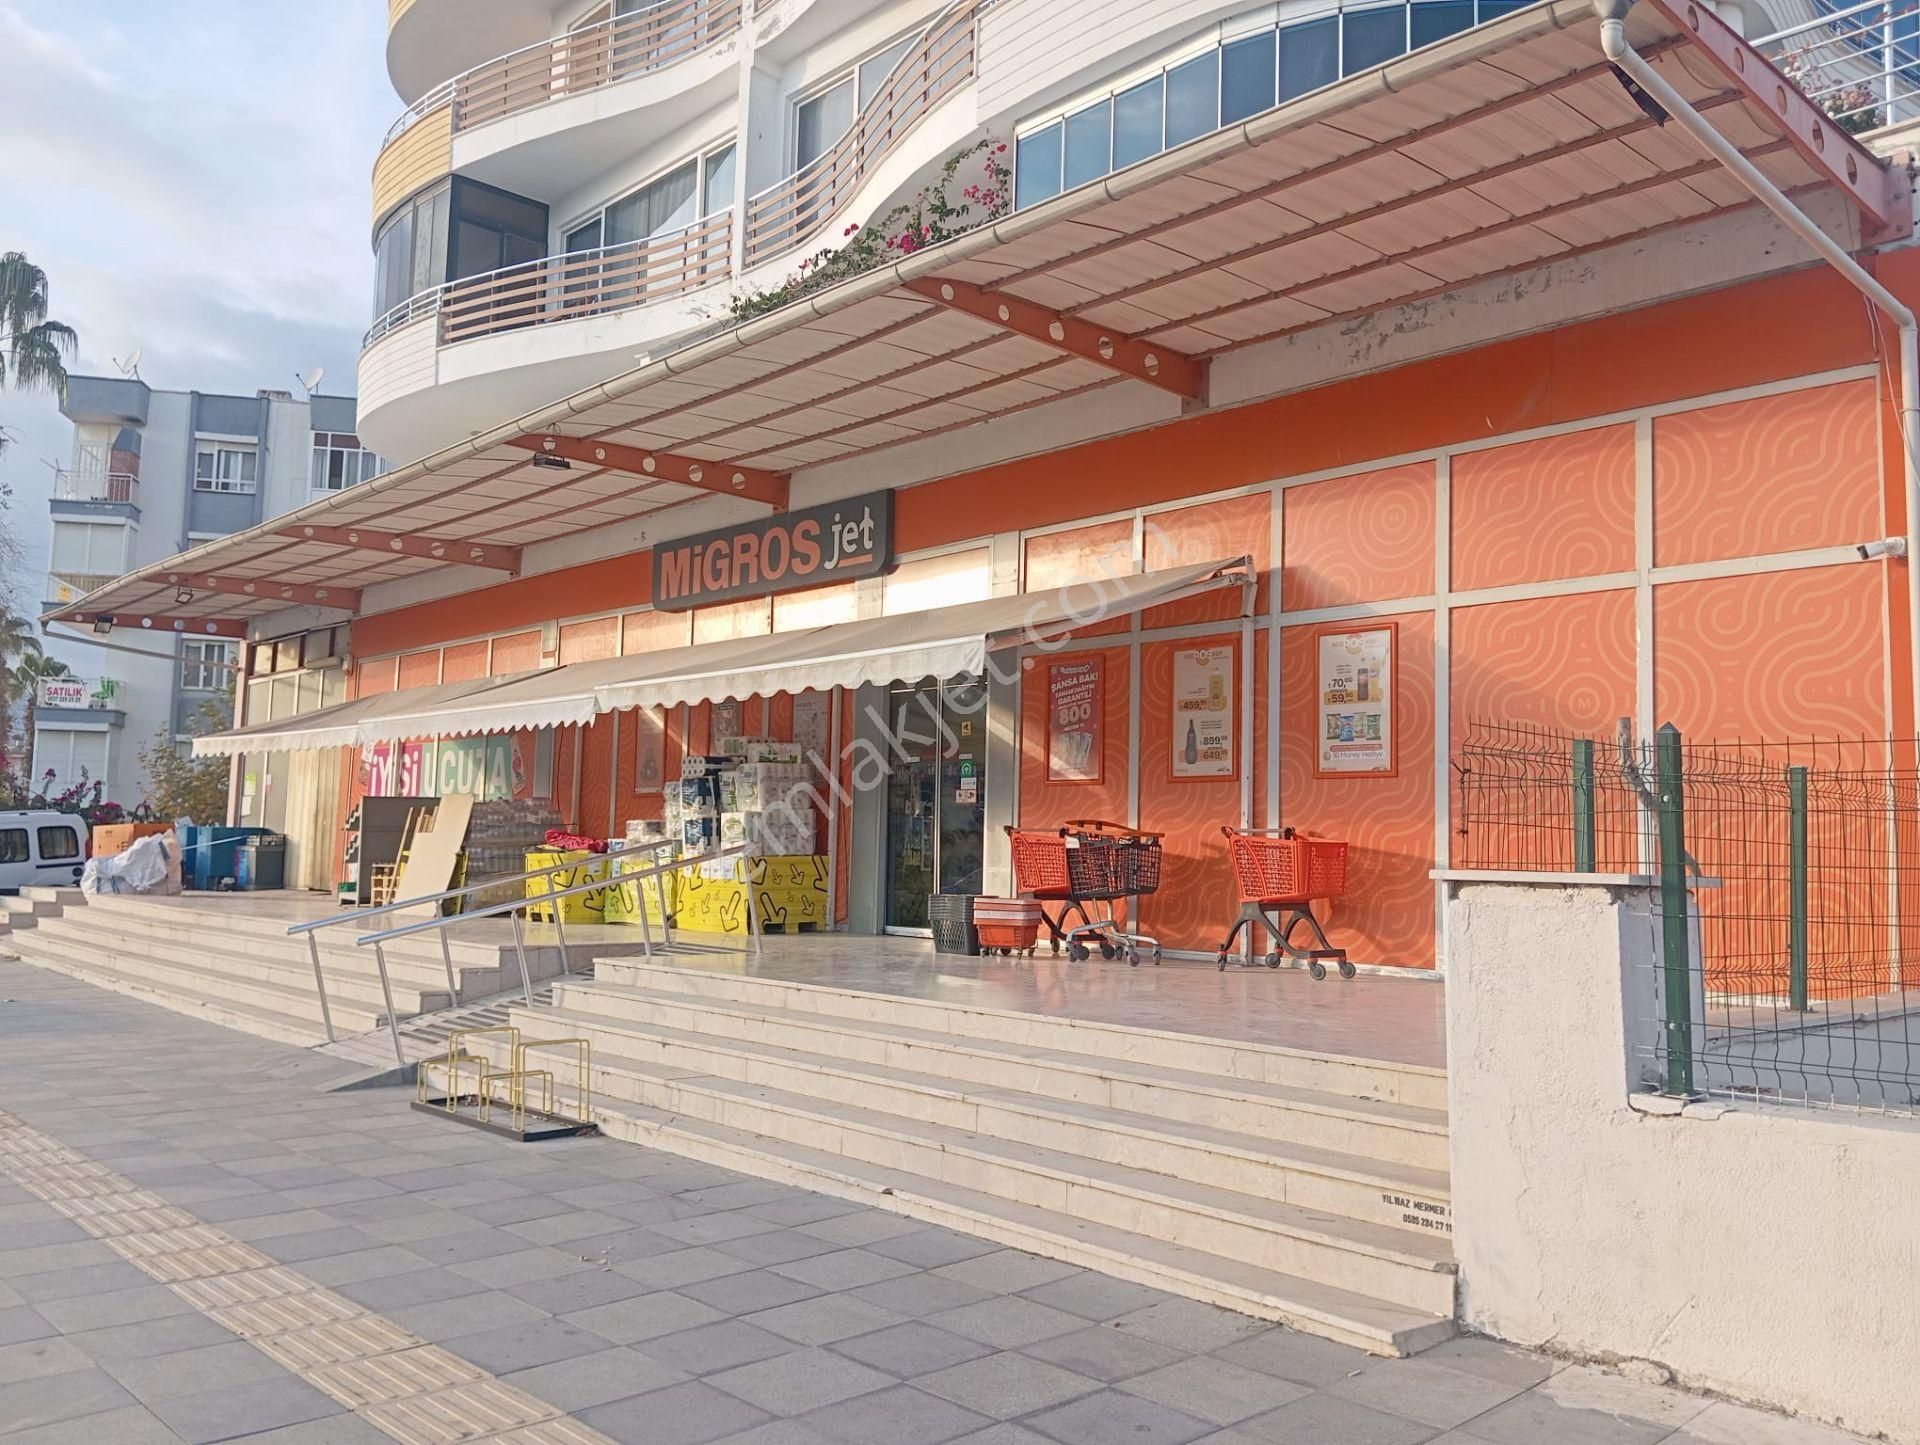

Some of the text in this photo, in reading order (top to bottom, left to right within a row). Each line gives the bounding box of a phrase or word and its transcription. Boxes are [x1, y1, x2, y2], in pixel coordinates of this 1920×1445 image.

[824, 505, 875, 570] jet
[46, 686, 83, 697] SATILIK
[1059, 703, 1091, 725] 800
[1413, 1200, 1445, 1216] MERMER
